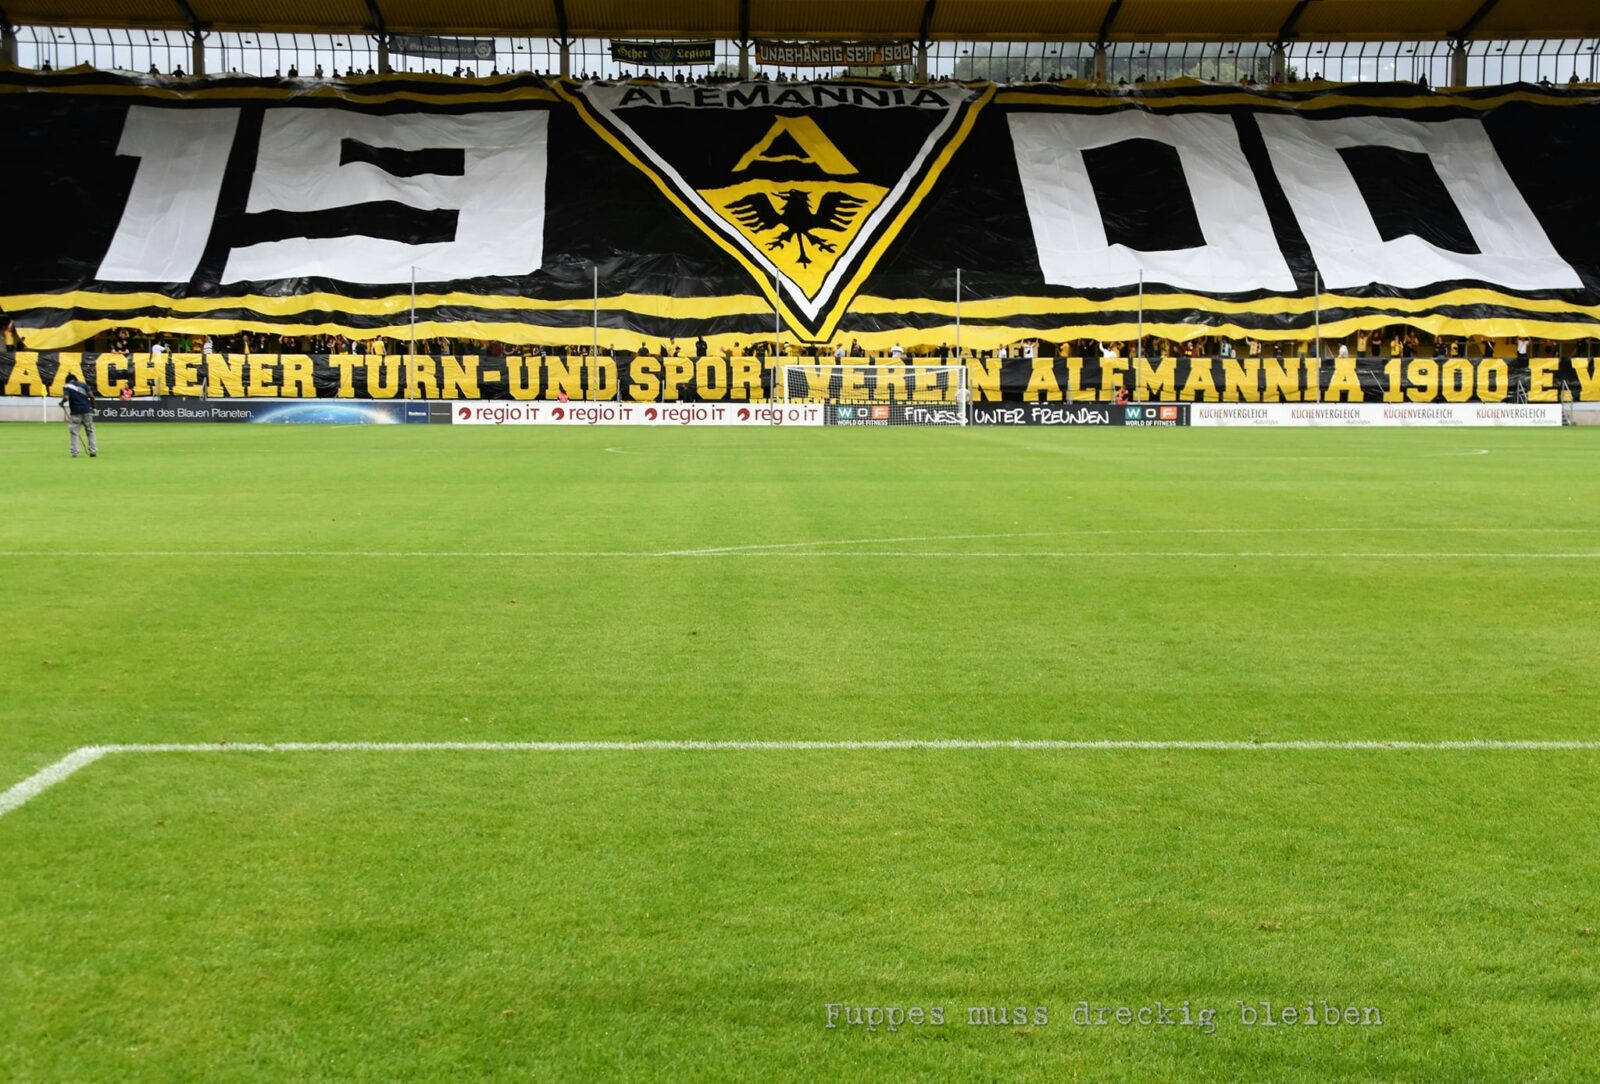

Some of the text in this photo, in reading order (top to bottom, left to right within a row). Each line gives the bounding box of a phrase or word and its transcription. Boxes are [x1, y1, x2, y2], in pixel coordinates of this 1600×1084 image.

[676, 48, 711, 60] Legion
[760, 43, 910, 63] UNABHÄNGIG SEIT 1900
[619, 84, 950, 108] ALEMANNIA
[731, 115, 859, 175] A
[4, 352, 317, 398] AACHENER
[629, 356, 798, 401] SPORT
[799, 357, 1003, 402] VEREIN
[1023, 357, 1364, 402] ALEMANNIA
[1383, 358, 1509, 402] 1900
[103, 407, 118, 417] die
[120, 407, 154, 417] Zukunft
[157, 407, 175, 417] des
[177, 407, 208, 417] Blauen
[476, 404, 521, 424] regio
[569, 404, 615, 424] regio
[662, 404, 707, 424] regio
[755, 404, 799, 424] rego
[974, 408, 1026, 424] UNTER
[1032, 406, 1109, 424] FREUNDEN
